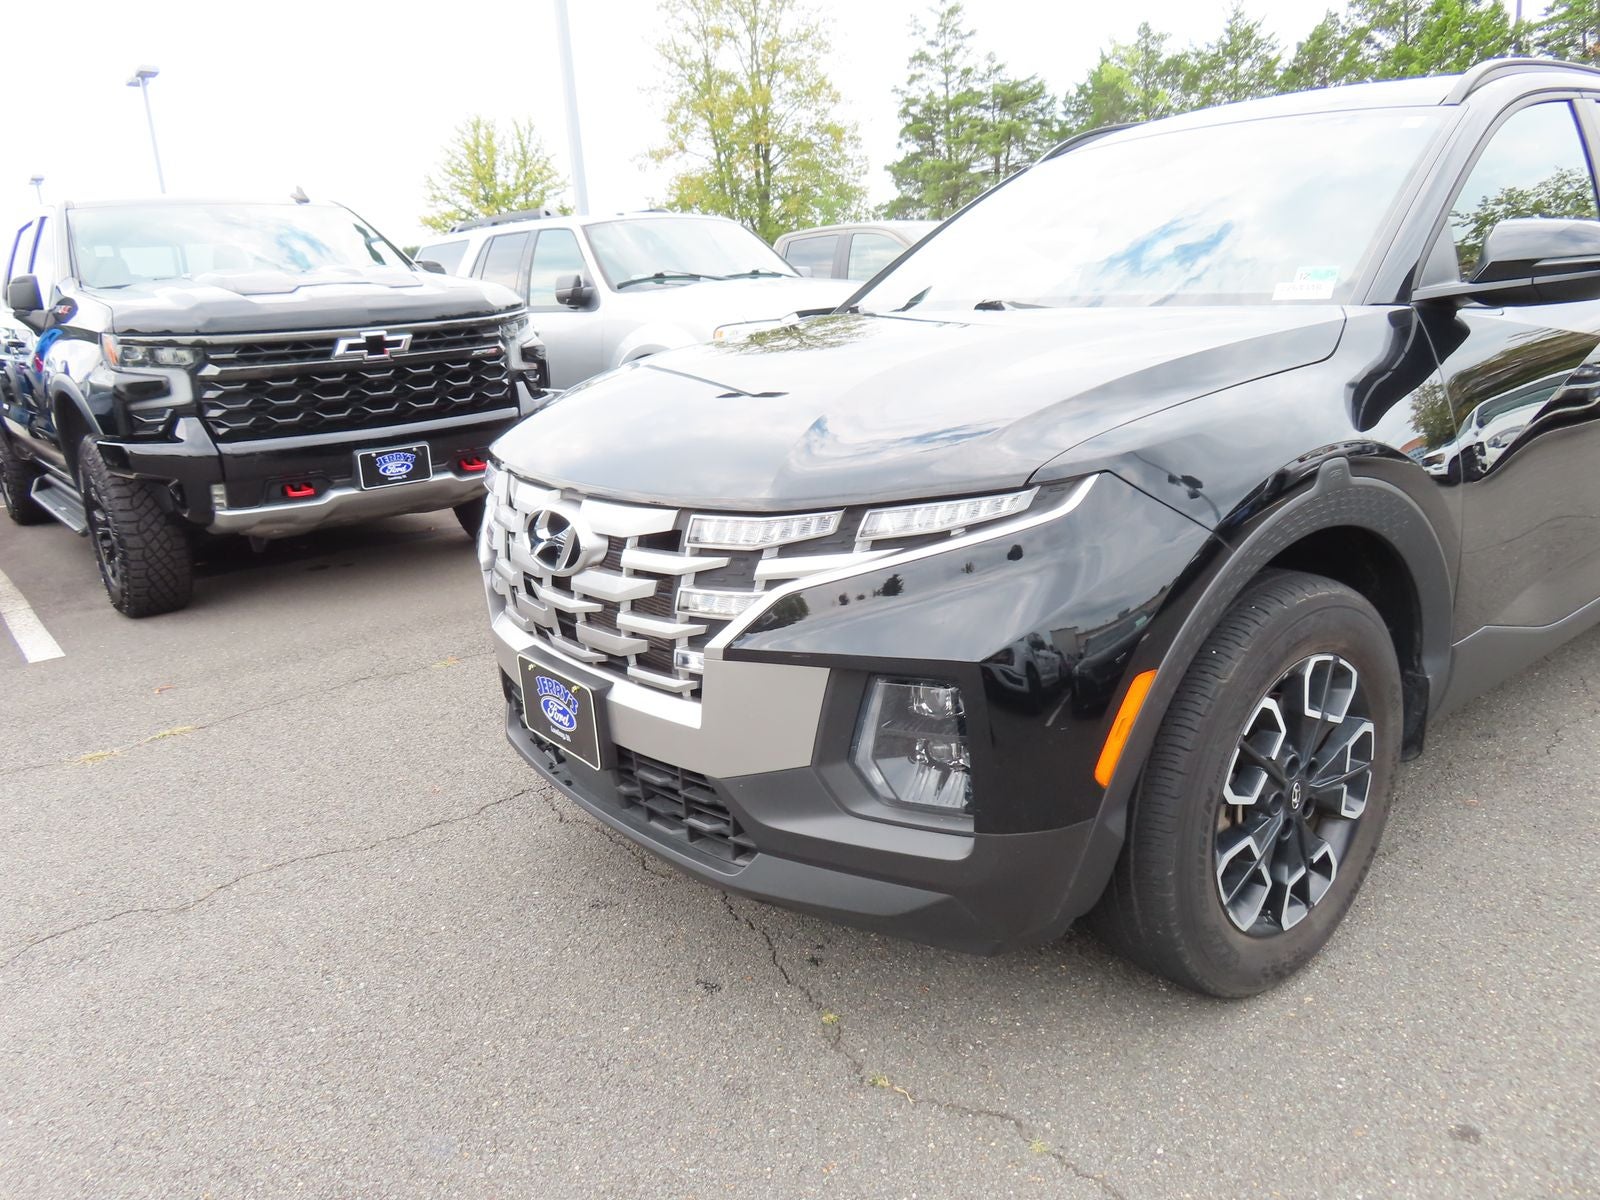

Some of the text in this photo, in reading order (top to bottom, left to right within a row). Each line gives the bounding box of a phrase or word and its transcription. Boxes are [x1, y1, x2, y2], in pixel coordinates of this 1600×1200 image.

[386, 463, 408, 475] Ford
[535, 675, 579, 715] JERRY'S
[547, 700, 571, 727] Ford
